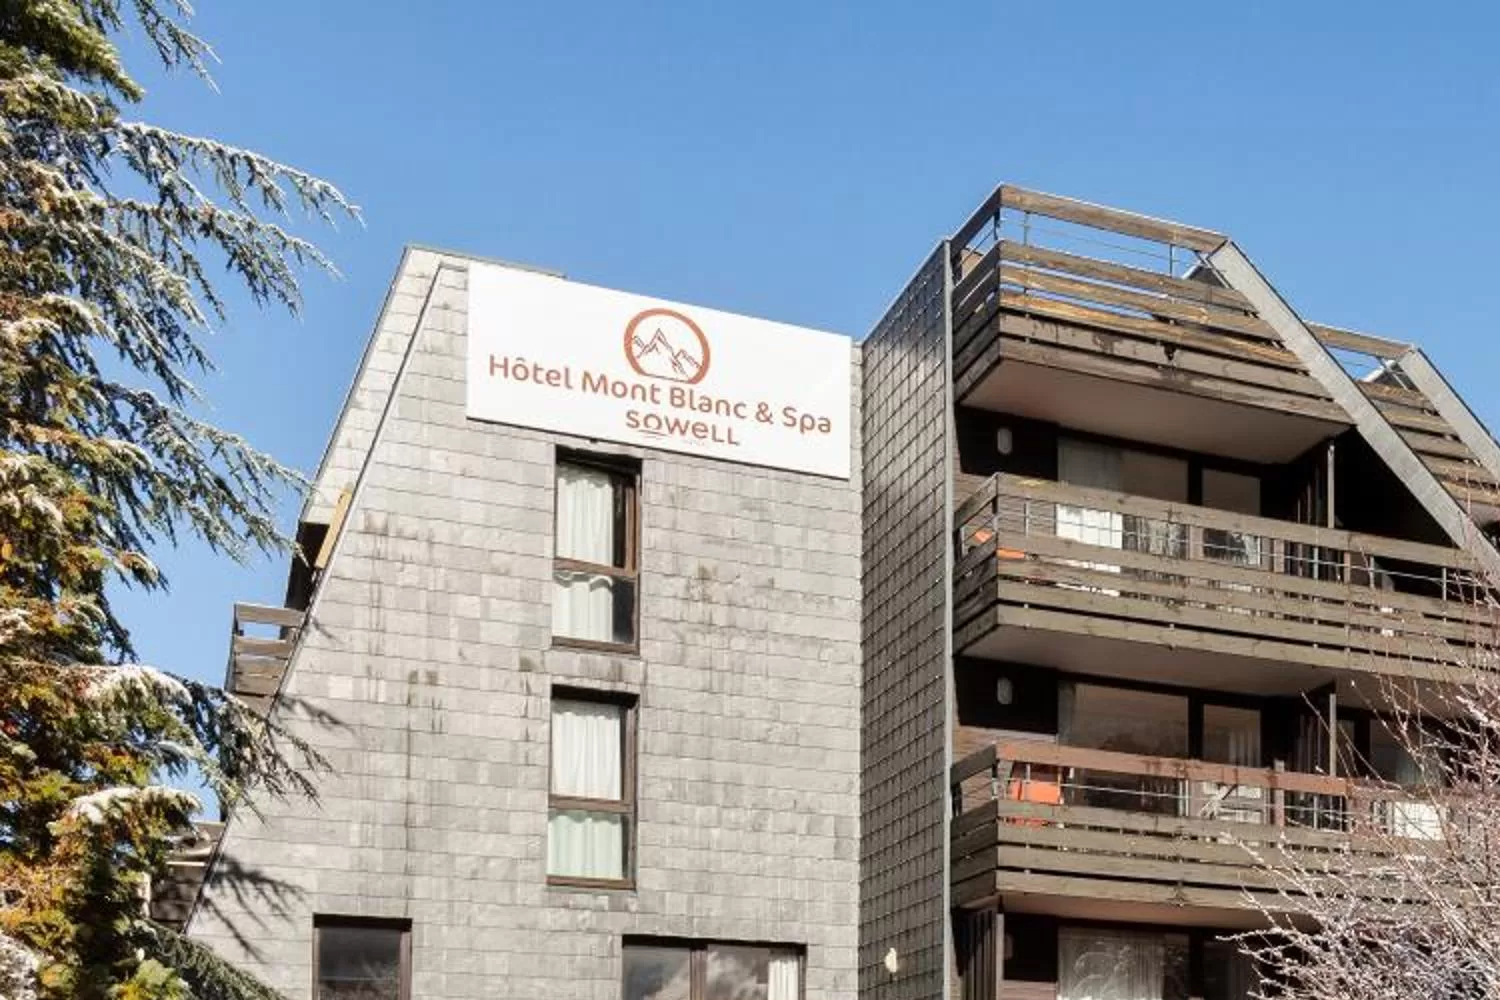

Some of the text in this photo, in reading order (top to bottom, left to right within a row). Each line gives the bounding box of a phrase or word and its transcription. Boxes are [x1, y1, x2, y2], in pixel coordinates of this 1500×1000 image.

[489, 354, 832, 434] Hôtel Mont Blanc & Spa
